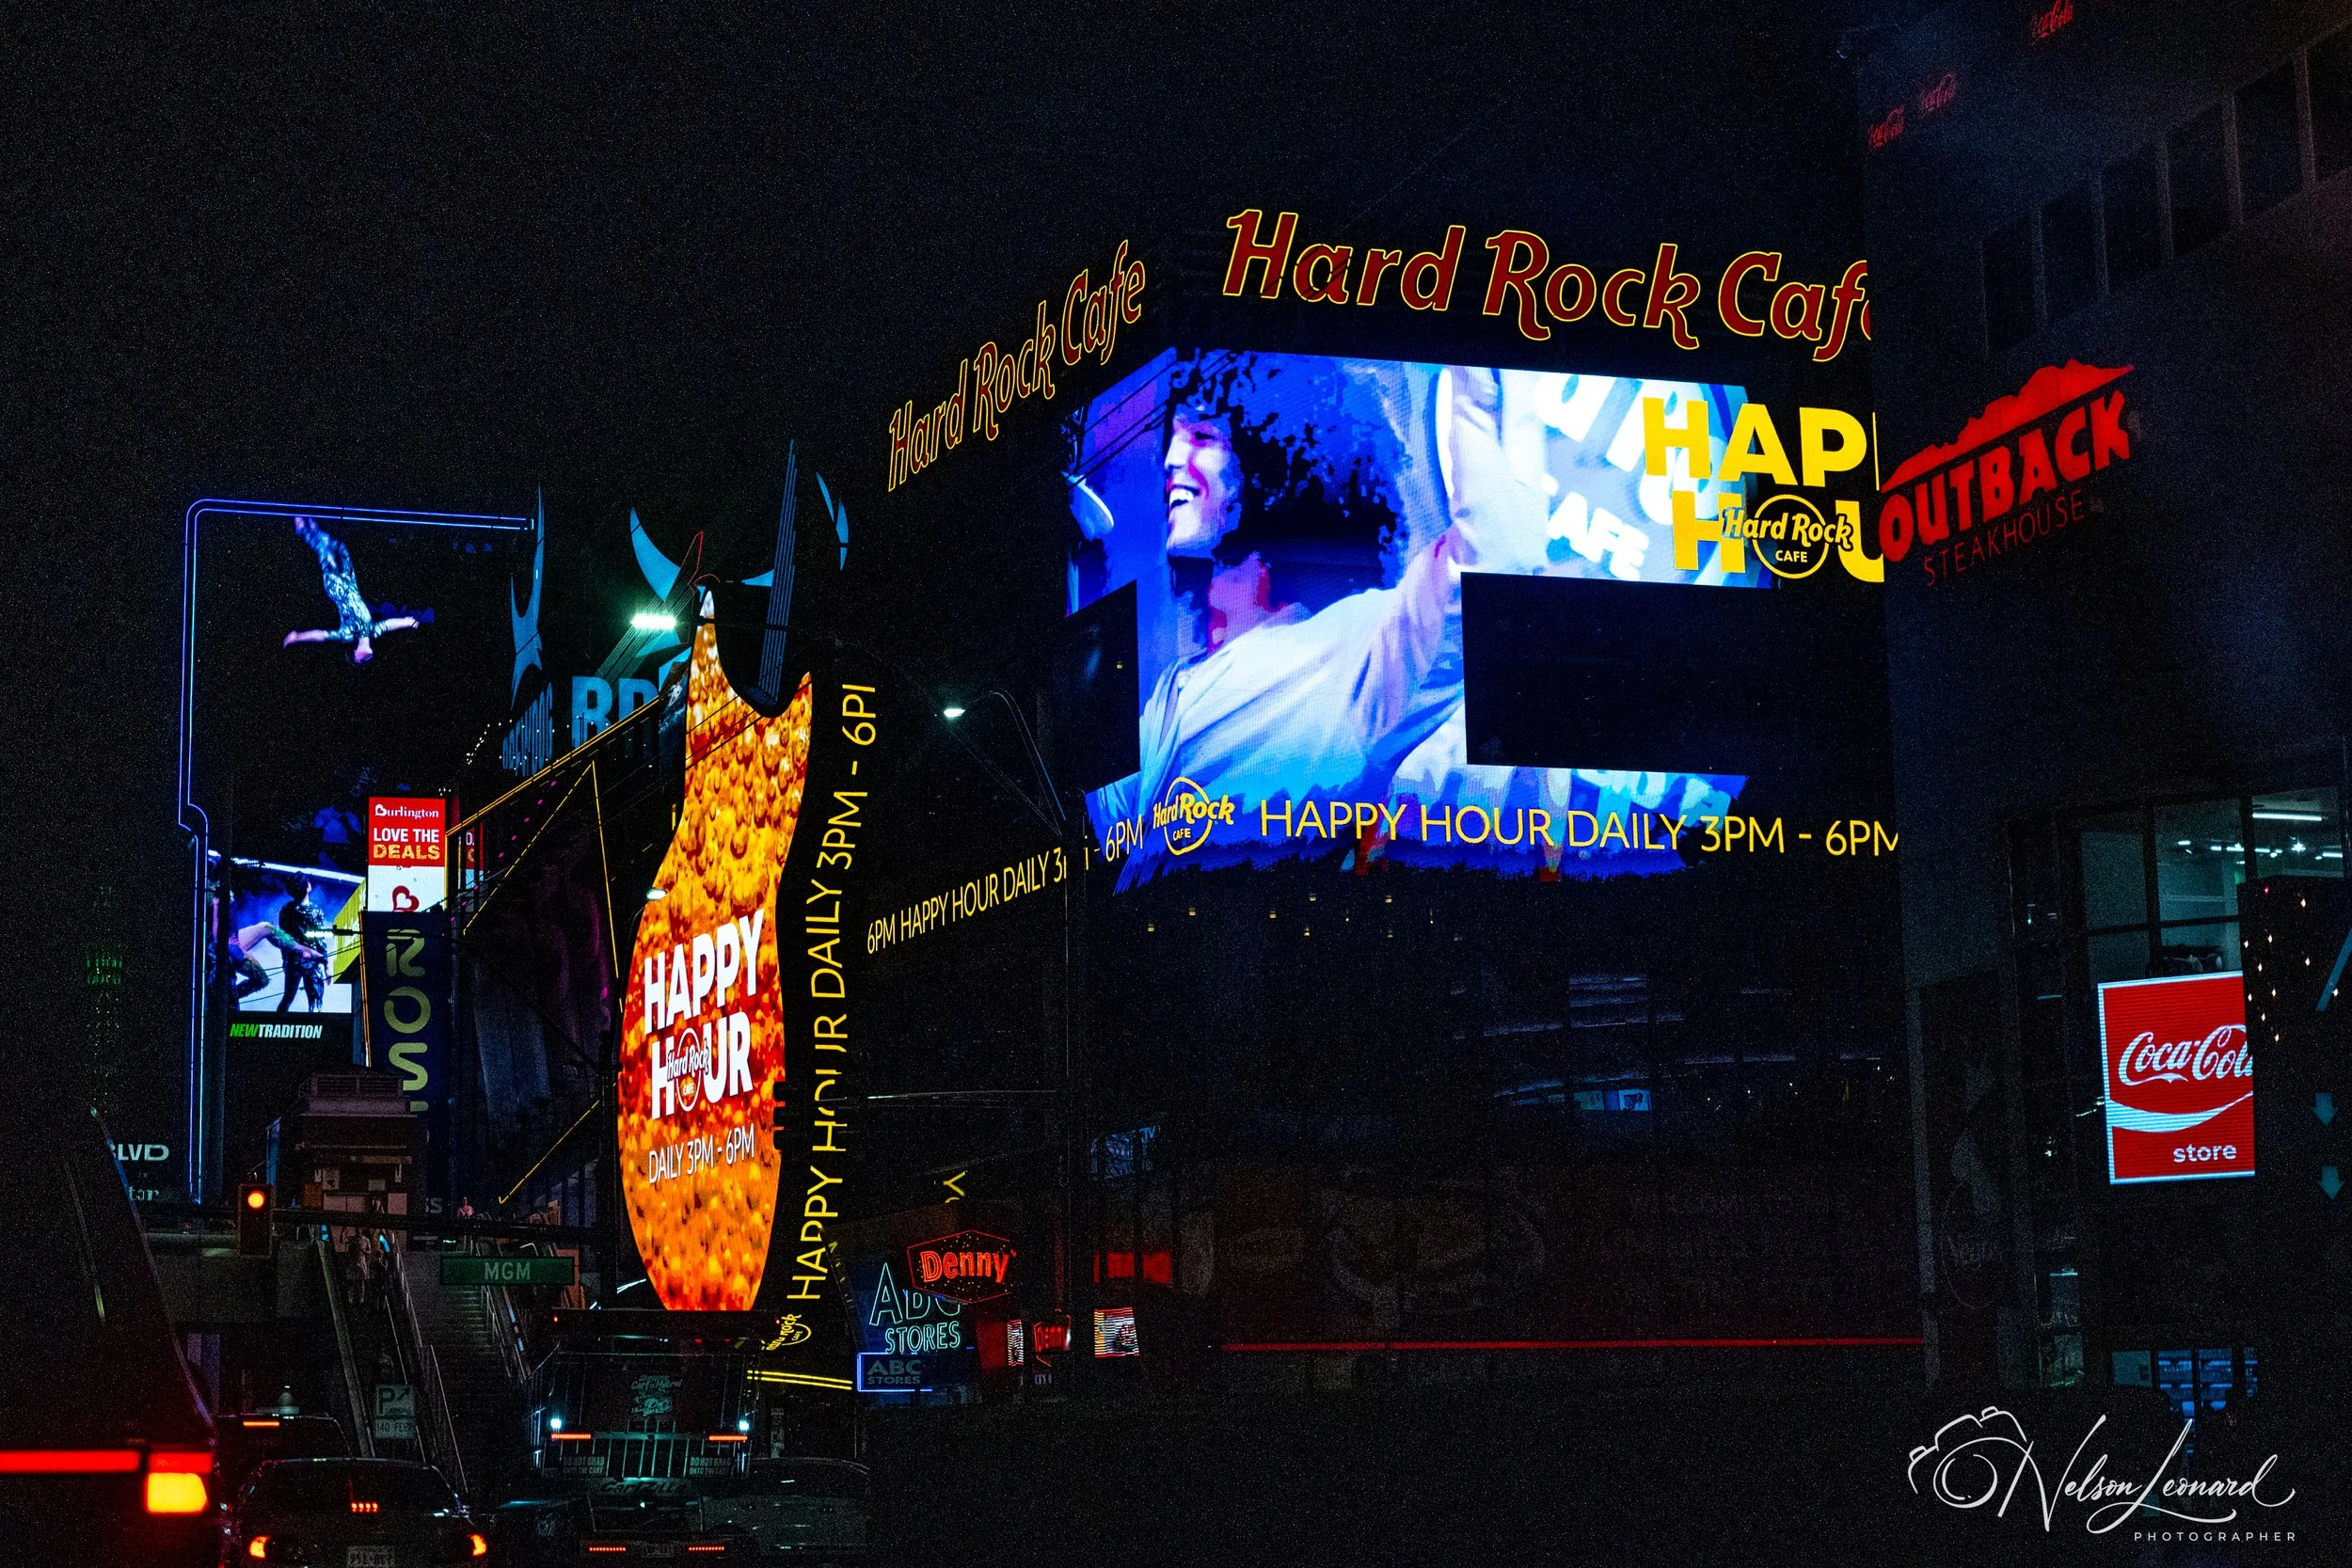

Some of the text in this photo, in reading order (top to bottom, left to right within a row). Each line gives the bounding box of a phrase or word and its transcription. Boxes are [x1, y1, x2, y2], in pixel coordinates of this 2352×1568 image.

[1223, 209, 1466, 312] Hard
[1483, 230, 1700, 350] Rock
[887, 238, 1147, 493] Hard Rock Cafe
[1643, 396, 1880, 492] HAP
[1880, 388, 2132, 563] OUTBACK
[1723, 509, 1853, 550] Hard Rock
[1922, 487, 2088, 587] STEAKHOUSE
[1774, 549, 1808, 562] CAFE
[841, 684, 877, 746] 6P
[373, 827, 439, 844] LOVE THE
[374, 803, 439, 820] Burlington
[816, 791, 868, 871] 3PM
[1152, 794, 1235, 830] Hard Rock
[1172, 828, 1191, 841] CAFE
[1260, 799, 1408, 841] HAPPY
[1421, 804, 1555, 847] HOUR
[1567, 810, 1689, 850] DAILY
[1700, 815, 1786, 854] 3PM
[1824, 818, 1899, 857] 6PM
[373, 844, 440, 860] DEALS
[866, 912, 897, 955] 6PM
[899, 891, 949, 942] HAPPY
[952, 873, 1000, 923] HOUR
[1002, 849, 1051, 903] DAILY
[1104, 813, 1144, 863] 6PM
[804, 878, 846, 998] DAILY
[644, 908, 765, 1036] HAPPY
[383, 928, 432, 1113] ROS
[667, 1037, 709, 1082] Hard Rock
[648, 1141, 685, 1184] DAILY
[687, 1133, 715, 1177] 3PM
[725, 1123, 755, 1167] 6PM
[2173, 1143, 2237, 1164] store
[484, 1261, 532, 1280] MGM
[884, 1320, 961, 1354] STORES
[866, 1359, 923, 1376] ABC
[867, 1376, 921, 1386] STORES
